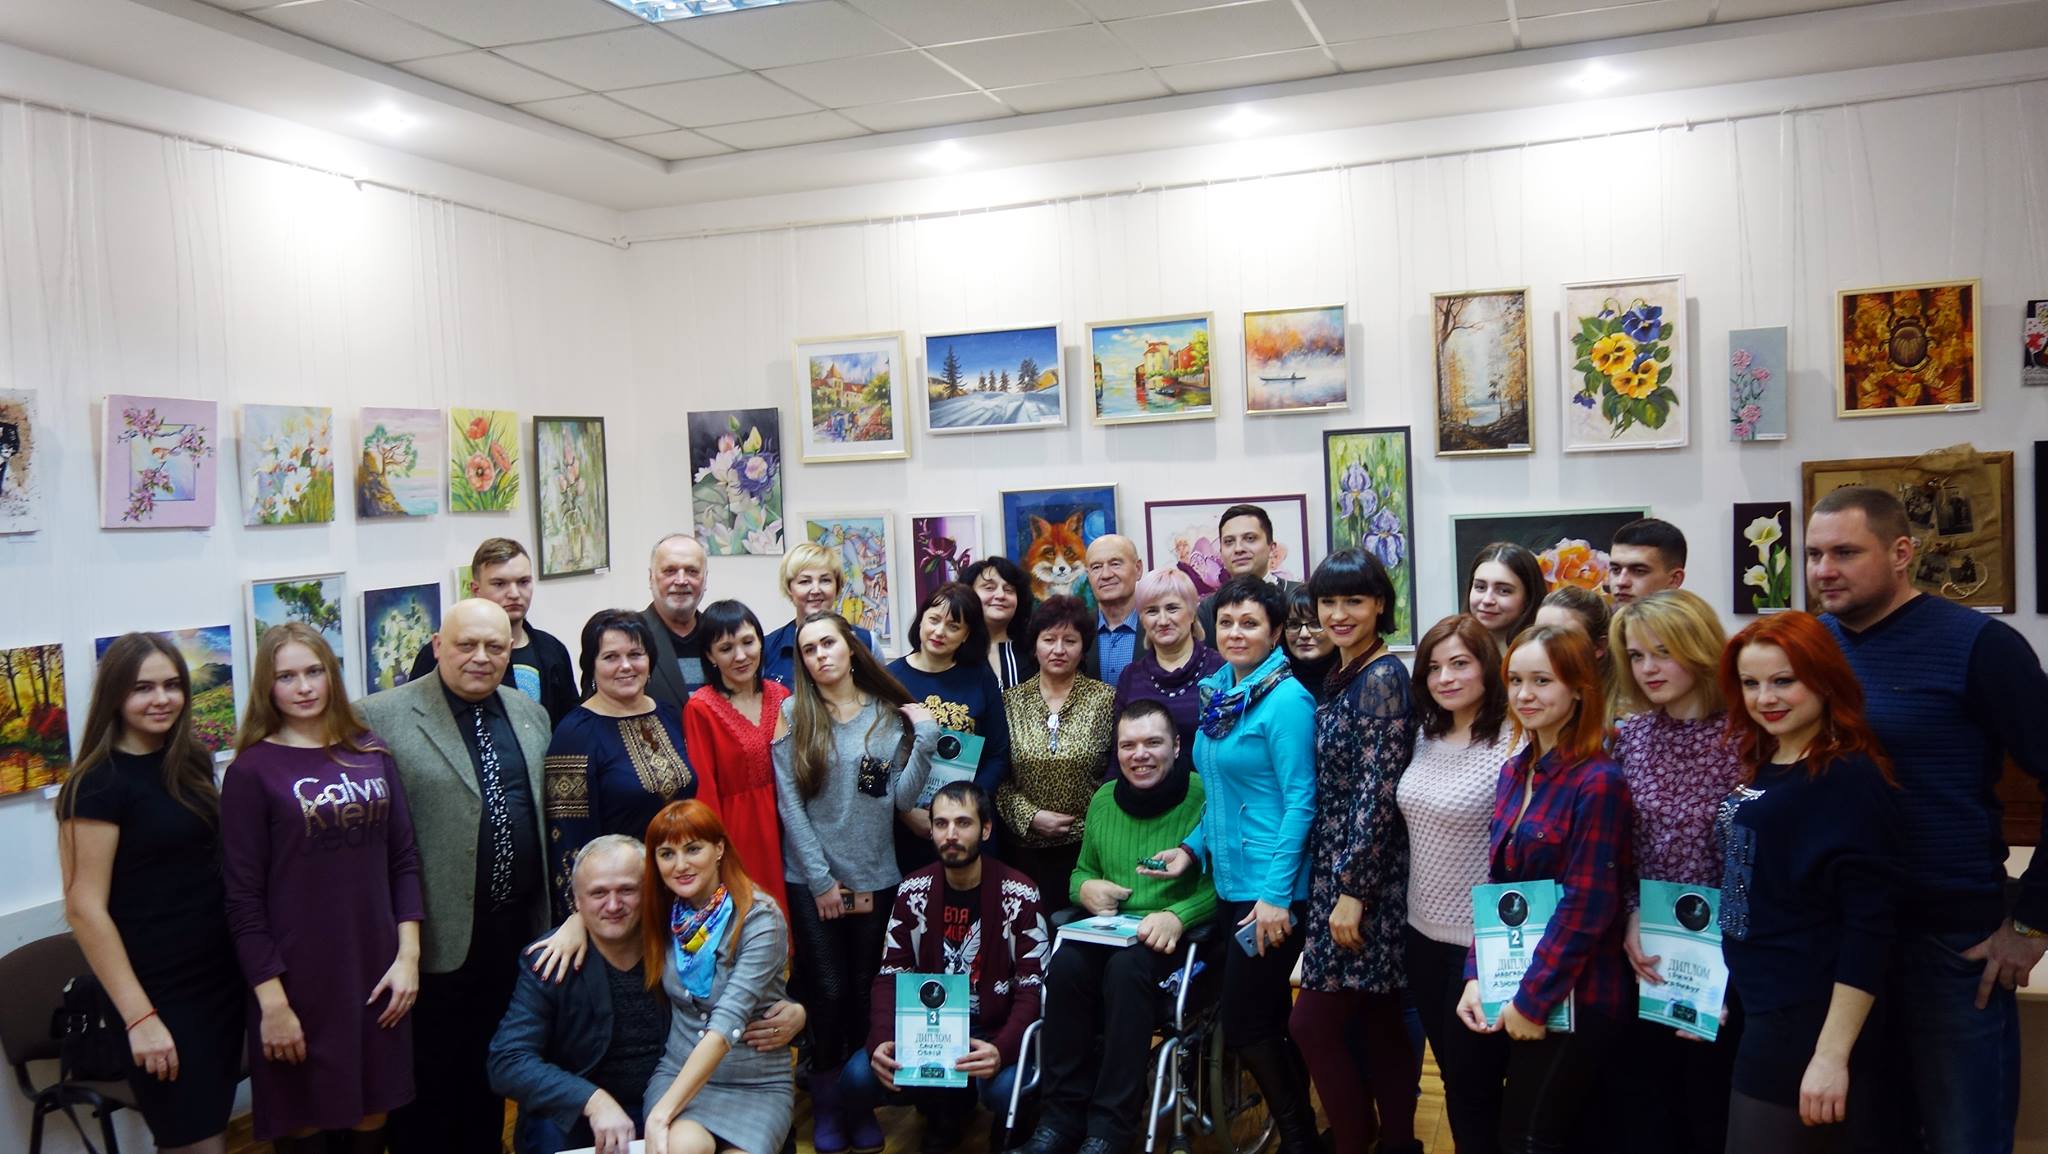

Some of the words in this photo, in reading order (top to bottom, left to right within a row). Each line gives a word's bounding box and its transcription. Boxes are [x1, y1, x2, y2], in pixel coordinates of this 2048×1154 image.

[1510, 929, 1521, 945] 2
[1496, 957, 1532, 971] ДИПЛО
[1667, 958, 1712, 980] ДИПЛОМ
[929, 1011, 938, 1024] 3
[915, 1032, 952, 1044] ДИПЛОМ
